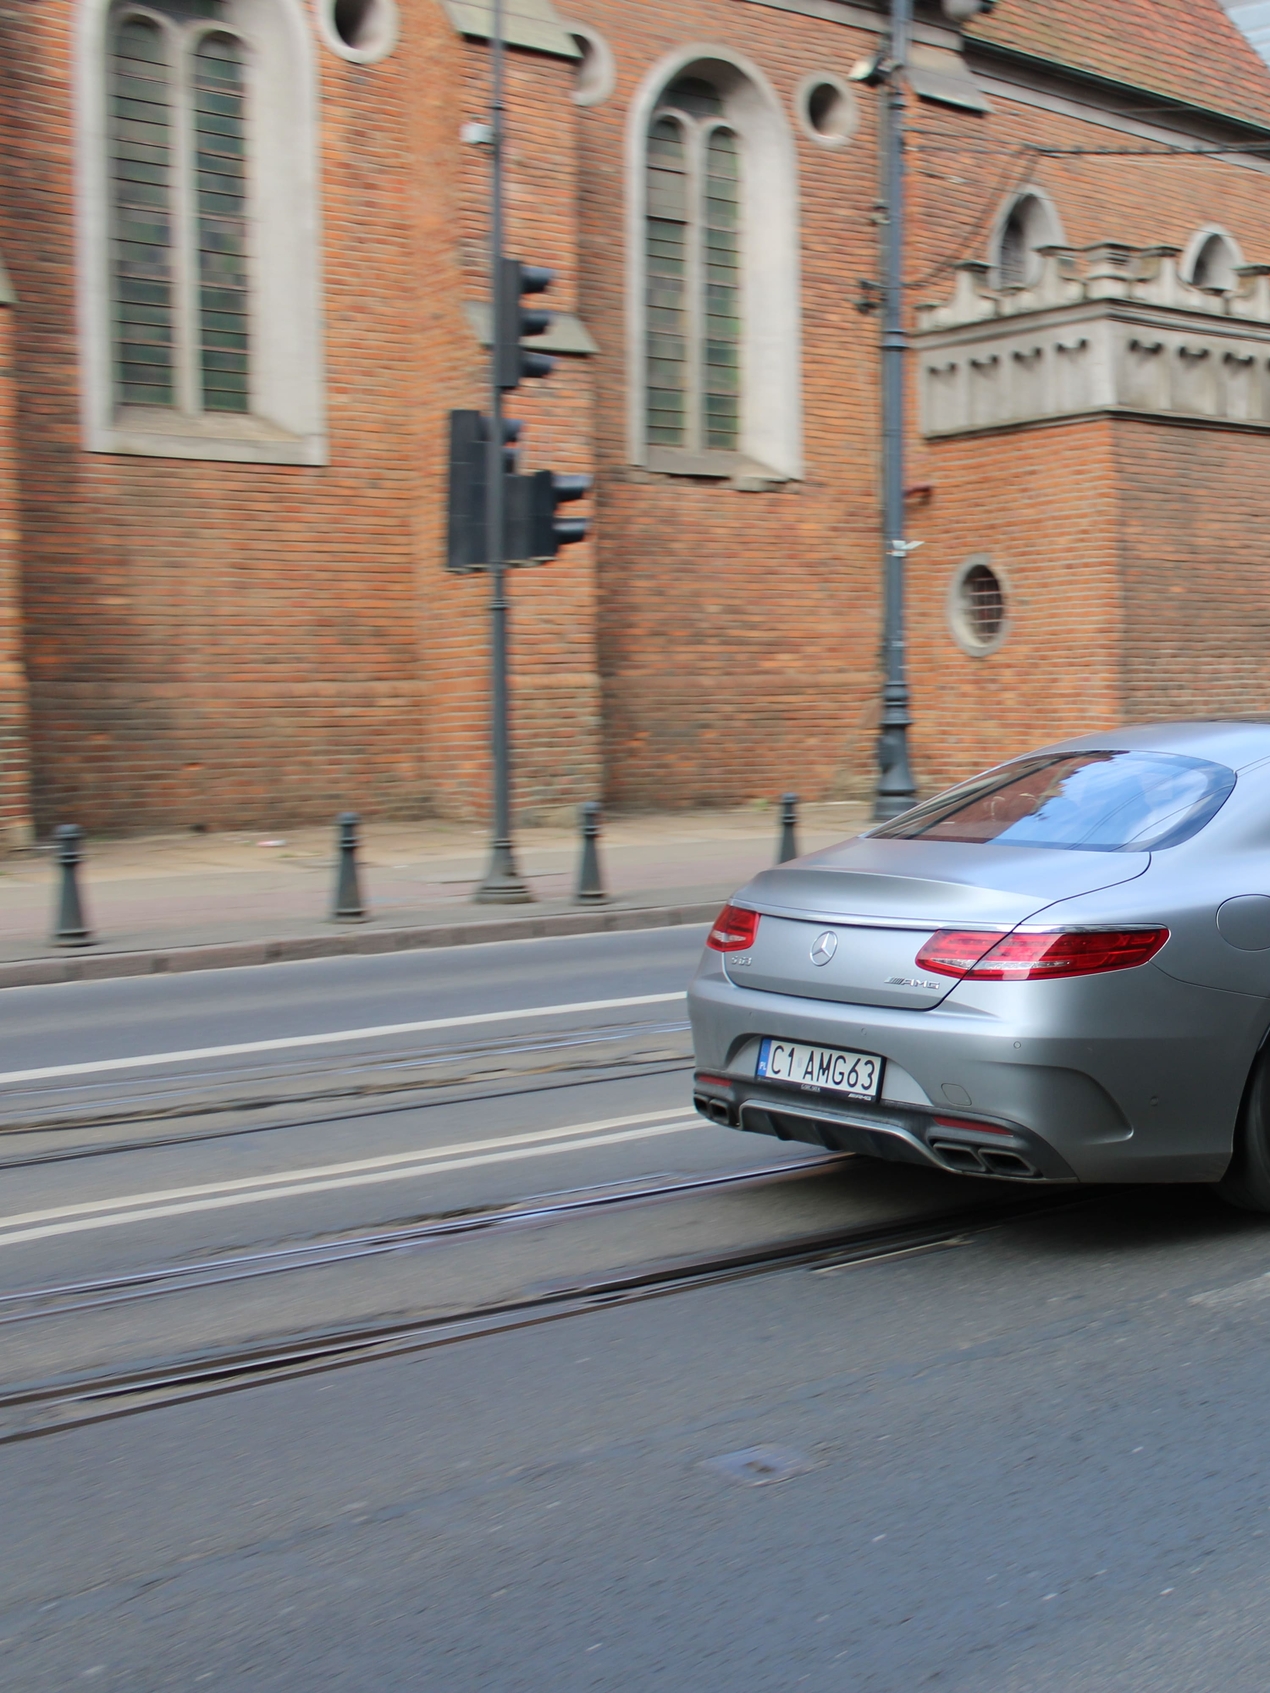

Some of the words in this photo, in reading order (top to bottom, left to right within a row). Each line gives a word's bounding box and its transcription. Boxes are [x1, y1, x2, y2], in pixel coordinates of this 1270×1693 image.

[900, 978, 940, 990] AMG
[759, 1061, 767, 1070] PL
[771, 1045, 795, 1077] C1
[802, 1048, 875, 1090] AMG63
